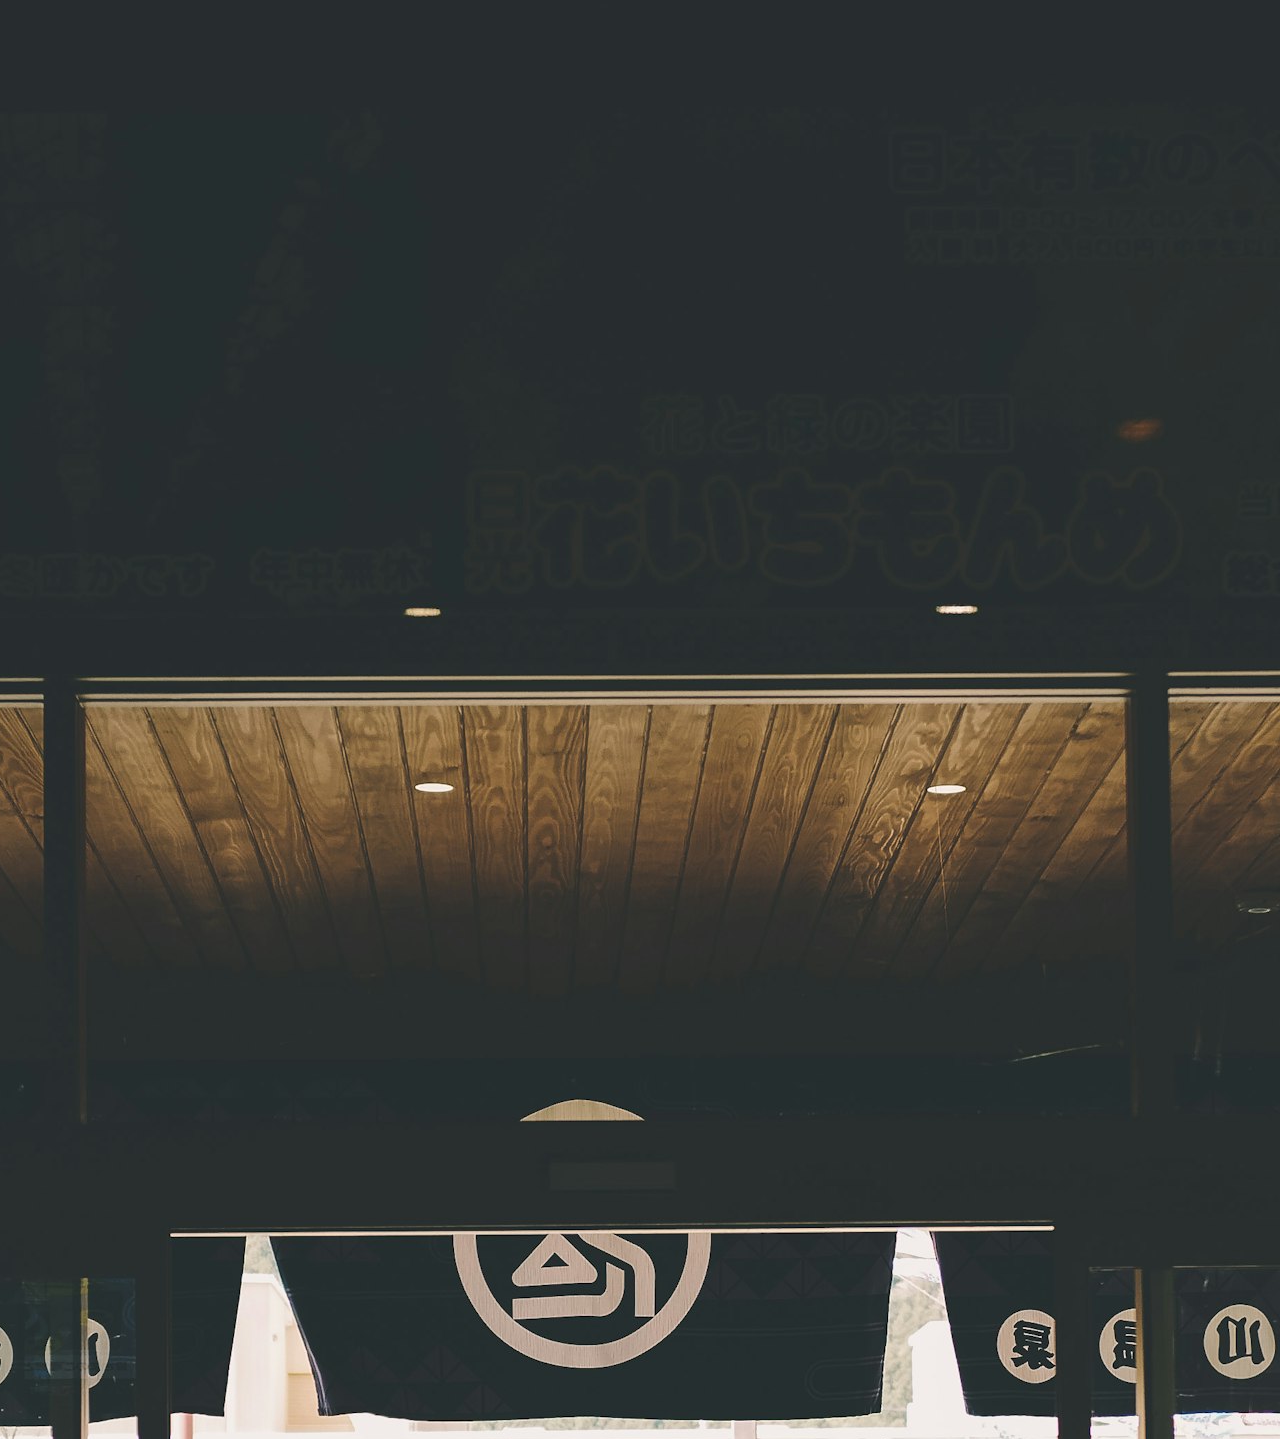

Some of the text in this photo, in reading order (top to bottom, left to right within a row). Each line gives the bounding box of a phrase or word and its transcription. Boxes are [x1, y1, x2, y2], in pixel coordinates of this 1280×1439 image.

[640, 392, 1015, 456] 花と緑の楽園
[530, 464, 1186, 590] 花いちもんめ
